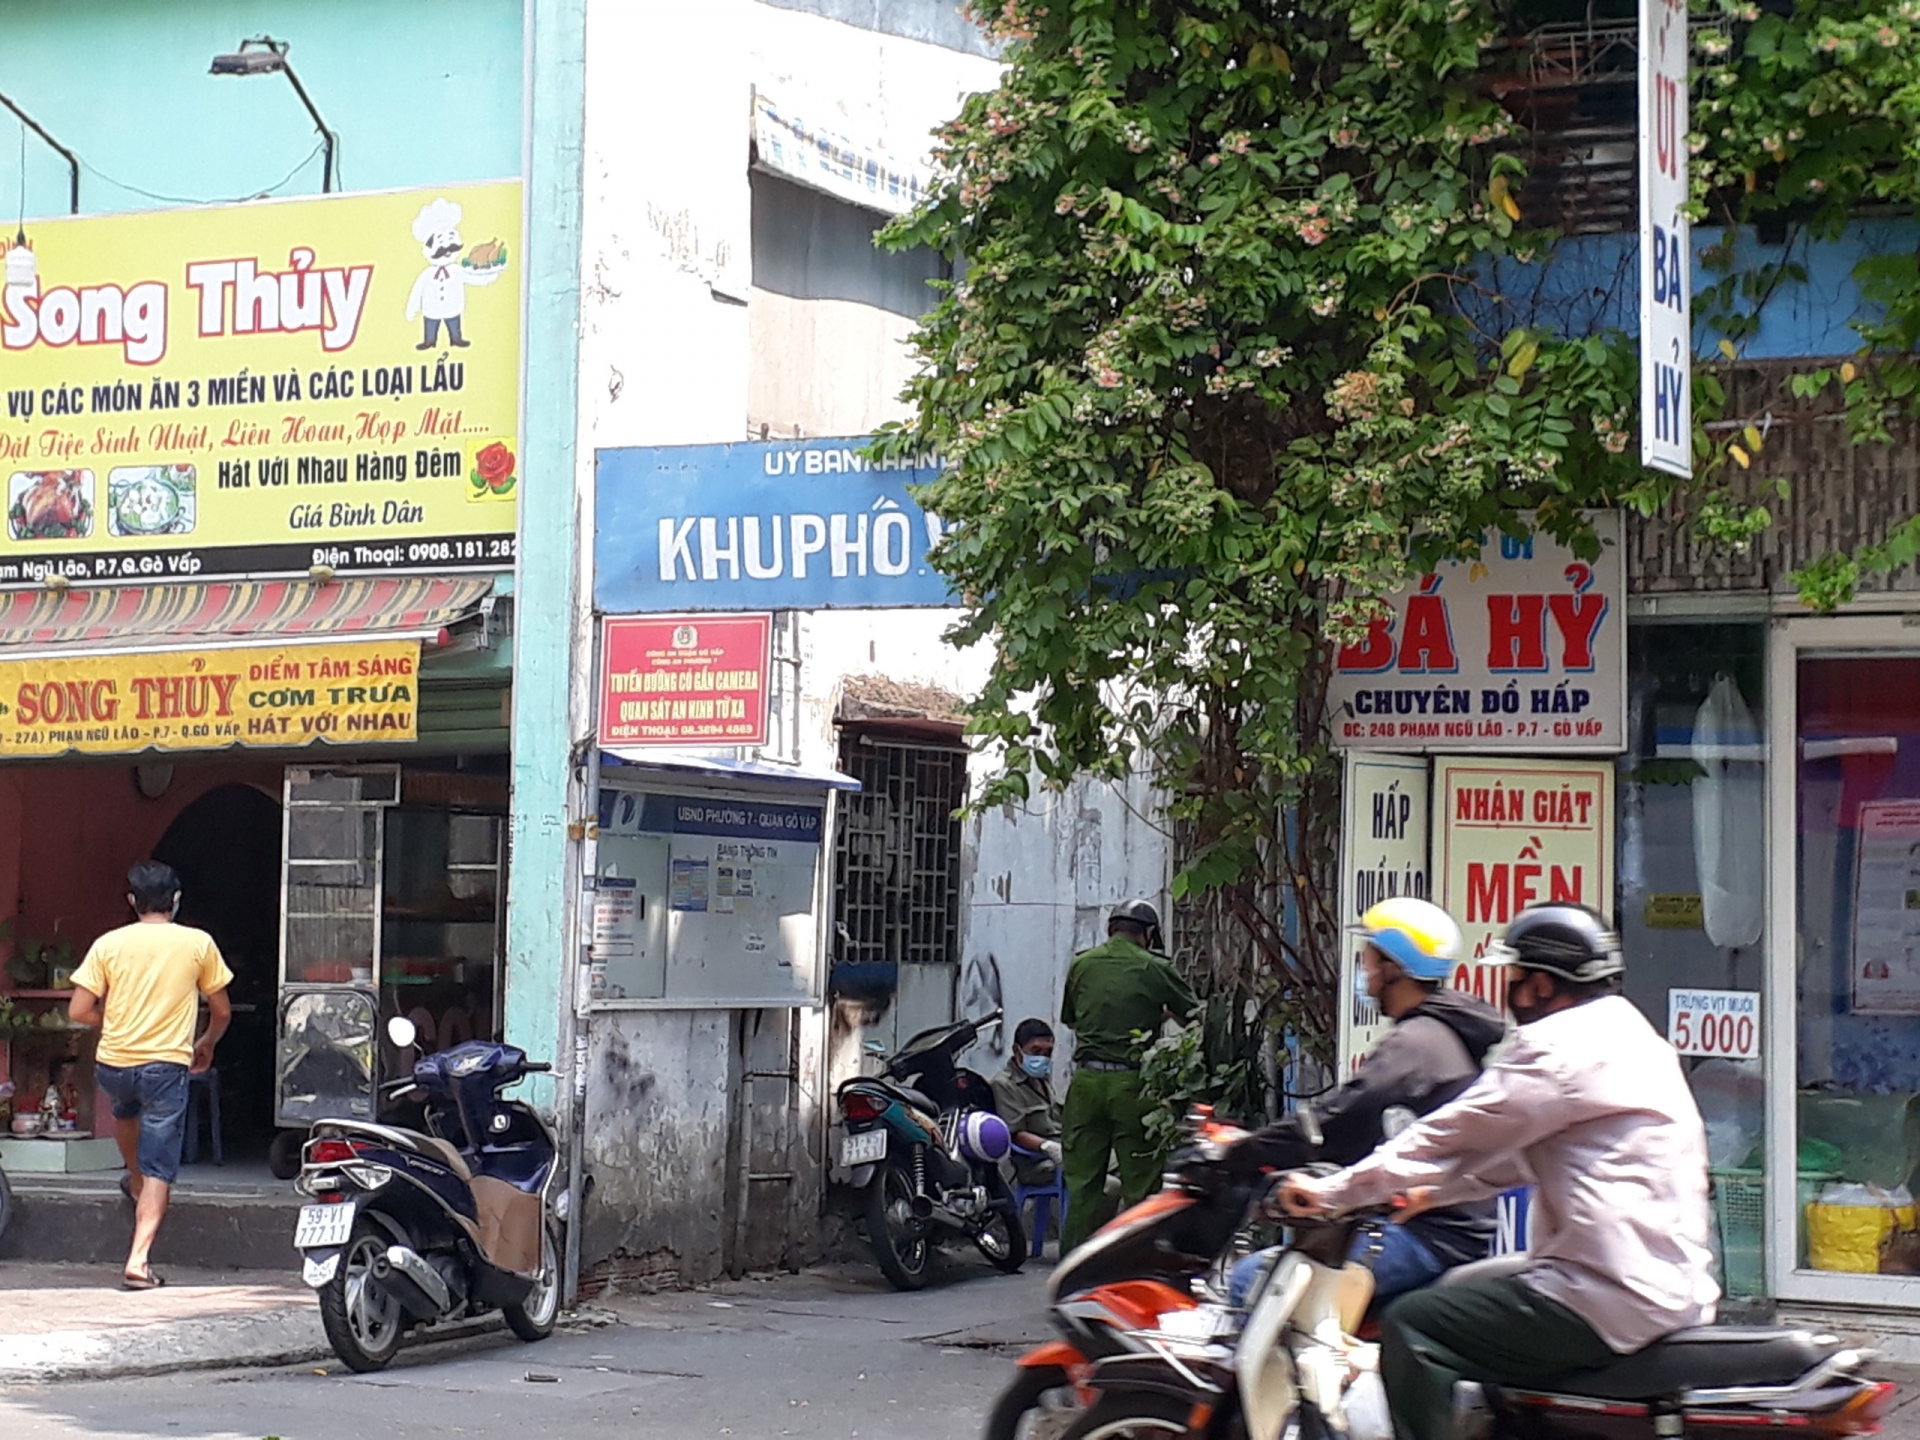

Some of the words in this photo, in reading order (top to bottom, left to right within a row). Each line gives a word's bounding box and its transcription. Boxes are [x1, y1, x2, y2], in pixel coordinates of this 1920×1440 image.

[1653, 212, 1682, 313] BÁ
[1, 275, 168, 366] Song
[186, 248, 375, 352] Thủy
[8, 389, 34, 423] VỤ
[41, 381, 84, 415] CÁC
[91, 377, 142, 413] MÓN
[149, 376, 180, 409] ĂN
[187, 381, 200, 407] 3
[272, 367, 301, 401] VÀ
[309, 365, 354, 399] CÁC
[362, 366, 412, 401] LOẠI
[421, 352, 463, 392] LẨU
[1654, 337, 1683, 446] HỶ
[39, 429, 84, 461] Tiệc
[90, 426, 140, 454] Sinh
[221, 418, 270, 447] Liên
[218, 459, 250, 489] Hát
[258, 456, 289, 486] Với
[297, 456, 348, 485] Nhau
[356, 451, 407, 482] Hàng
[415, 447, 461, 478] Đêm
[289, 503, 323, 529] Giá
[329, 502, 376, 527] Bình
[382, 500, 424, 524] Dân
[22, 561, 54, 581] Ngũ
[168, 551, 201, 574] Vấp
[312, 548, 349, 567] Điện
[354, 548, 404, 568] Thoại:
[1337, 573, 1459, 674] BÁ
[1487, 563, 1608, 674] HỶ
[249, 654, 299, 681] ĐIỂM
[307, 657, 350, 678] TÂM
[357, 654, 412, 676] SÁNG
[611, 668, 642, 692] TUYẾN
[678, 668, 693, 691] CÓ
[716, 670, 758, 691] CAMERA
[16, 679, 120, 725] SONG
[130, 657, 241, 719] THỦY
[249, 687, 315, 708] CƠM
[327, 682, 411, 705] TRƯA
[620, 700, 649, 722] QUAN
[650, 696, 671, 720] SÁT
[672, 700, 687, 719] AN
[688, 699, 715, 719] NINH
[715, 695, 731, 719] TỪ
[730, 699, 745, 719] XA
[1355, 684, 1470, 714] CHUYÊN
[1481, 678, 1520, 714] ĐỒ
[1530, 679, 1590, 714] HẤP
[248, 713, 291, 735] HÁT
[301, 711, 338, 732] VỚI
[347, 712, 411, 731] NHAU
[1369, 722, 1396, 737] 248
[1400, 722, 1442, 739] PHẠM
[1445, 719, 1473, 737] NGŨ
[1477, 719, 1504, 737] LÃO
[1517, 721, 1538, 737] P.7
[1553, 719, 1571, 736] GÒ
[1575, 716, 1602, 736] VẤP
[705, 807, 746, 825] PHƯỜNG
[785, 813, 798, 829] GÒ
[1372, 779, 1410, 839] HẤP
[1533, 784, 1593, 827] GIẶT
[1466, 836, 1582, 923] MỀN
[1675, 1012, 1753, 1054] 5.000
